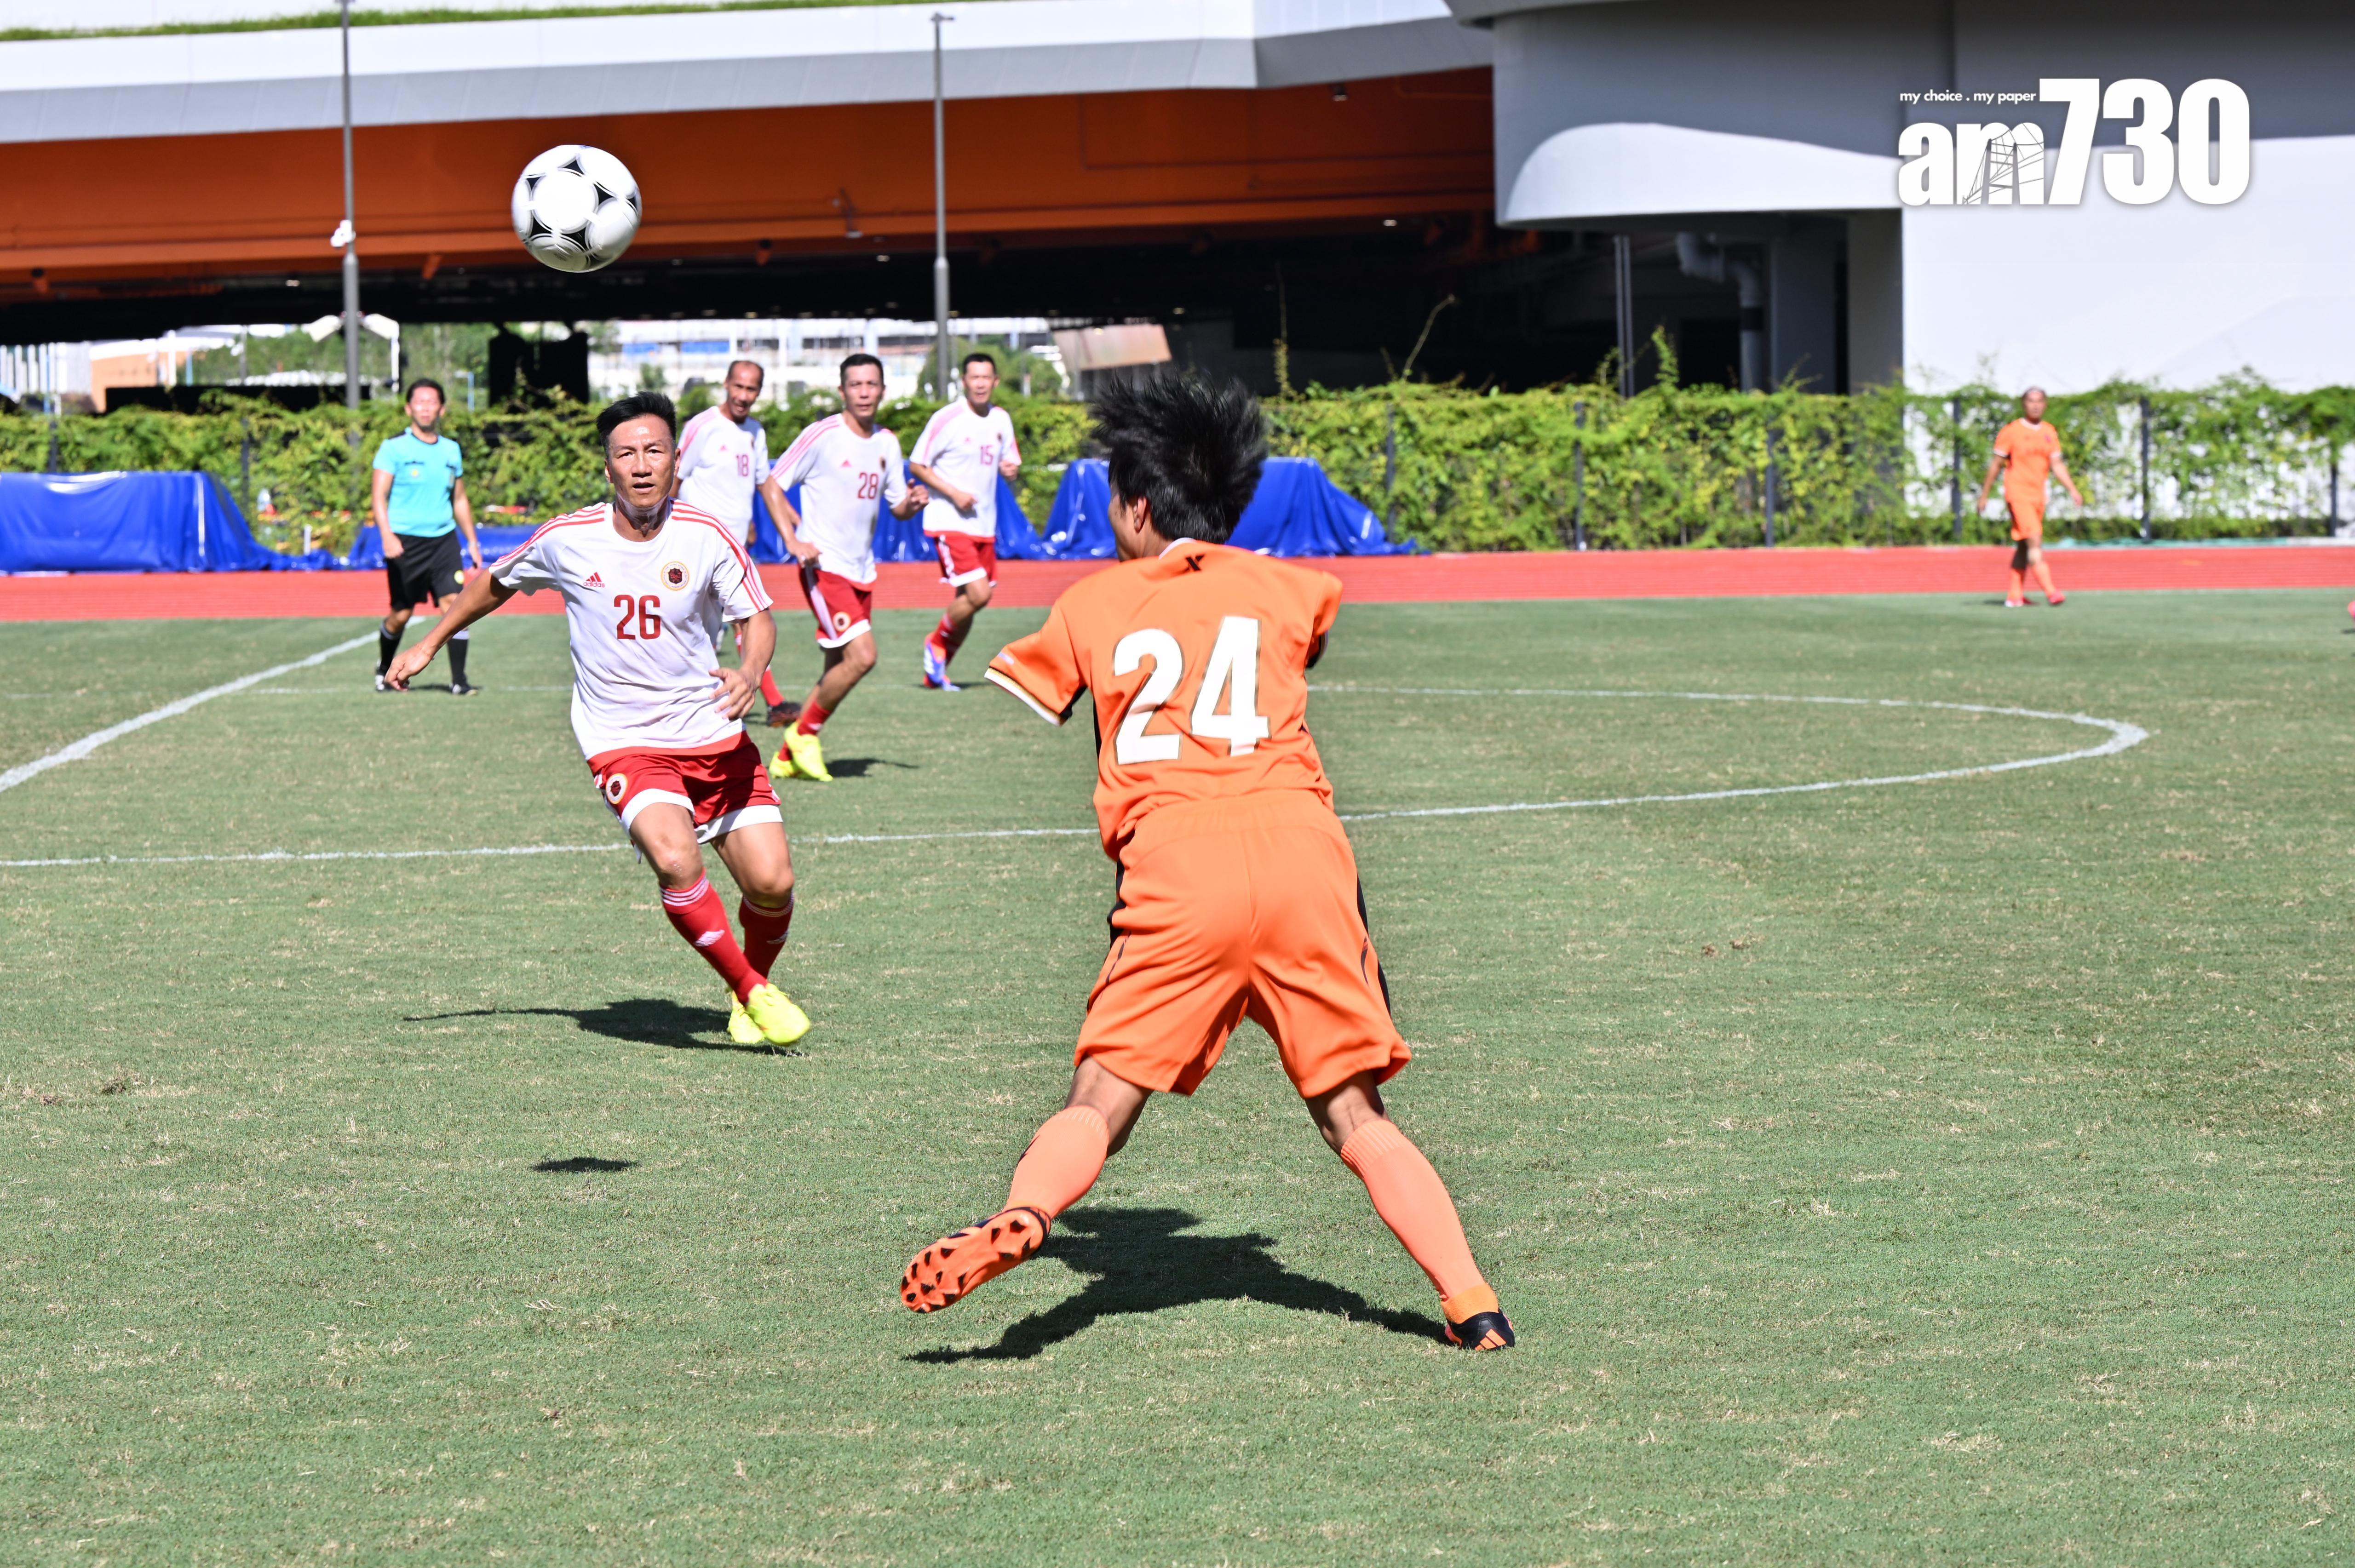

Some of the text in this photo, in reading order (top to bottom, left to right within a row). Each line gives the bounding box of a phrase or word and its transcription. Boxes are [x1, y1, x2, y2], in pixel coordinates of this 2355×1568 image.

[736, 454, 749, 476] 18
[980, 445, 994, 465] 15
[857, 472, 879, 499] 28
[614, 594, 661, 640] 26
[1113, 615, 1271, 766] 24
